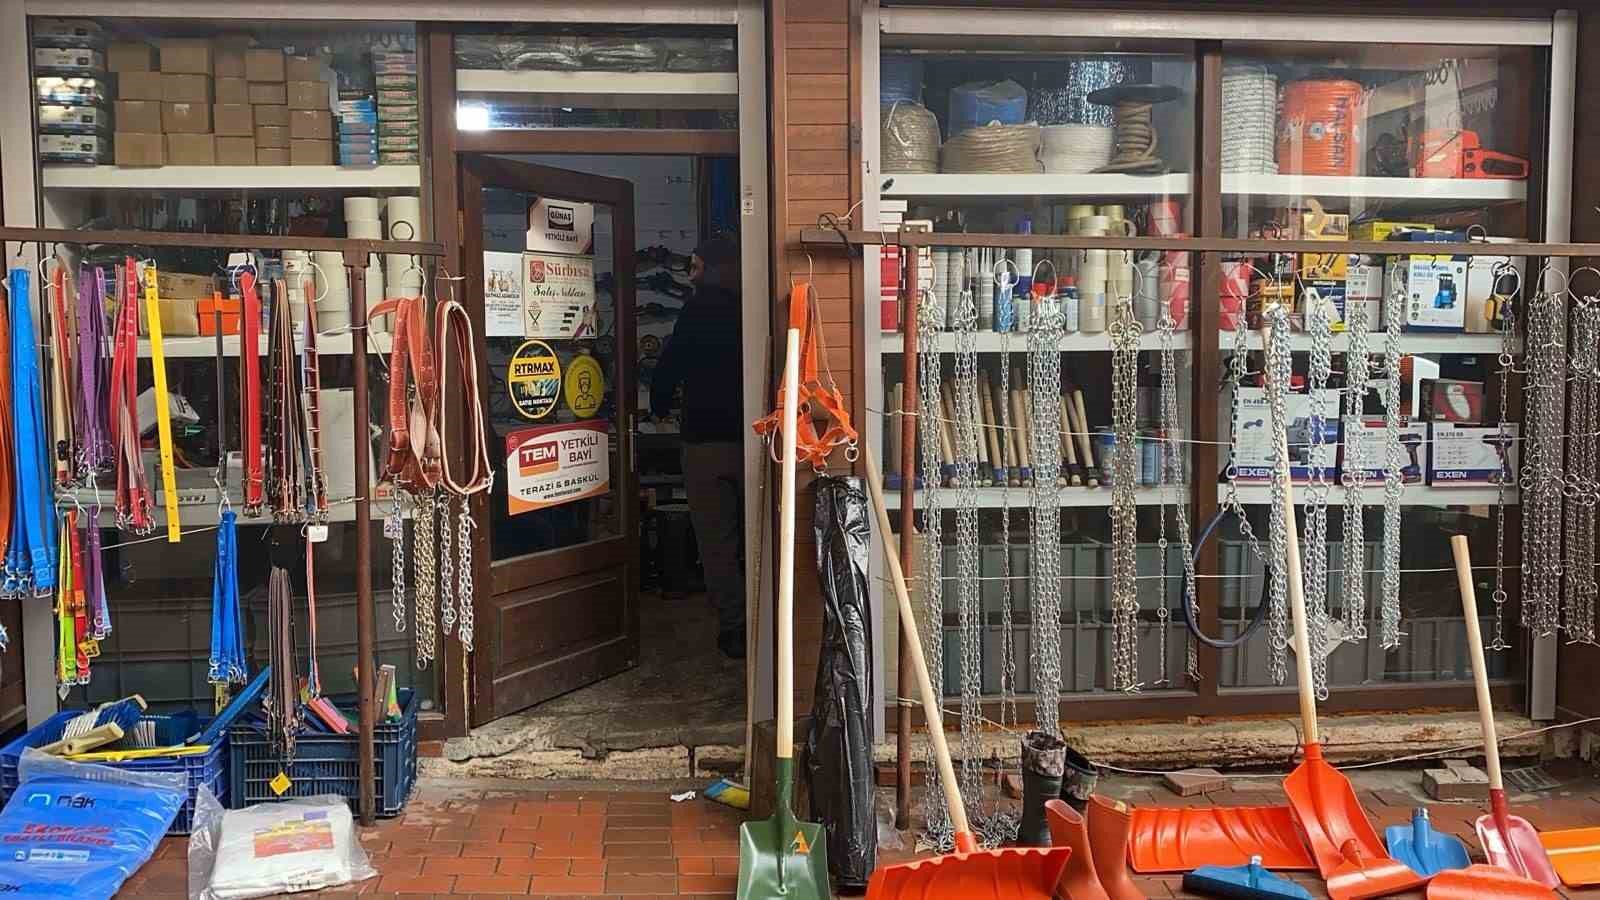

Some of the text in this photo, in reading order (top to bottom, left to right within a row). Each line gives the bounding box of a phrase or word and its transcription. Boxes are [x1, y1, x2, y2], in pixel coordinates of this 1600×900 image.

[514, 362, 554, 374] RTRMAX
[561, 433, 598, 450] YETKİLİ
[521, 445, 556, 463] TEM
[569, 447, 592, 462] BAYİ
[1436, 471, 1467, 479] EXEN
[520, 481, 554, 495] TERAZİ
